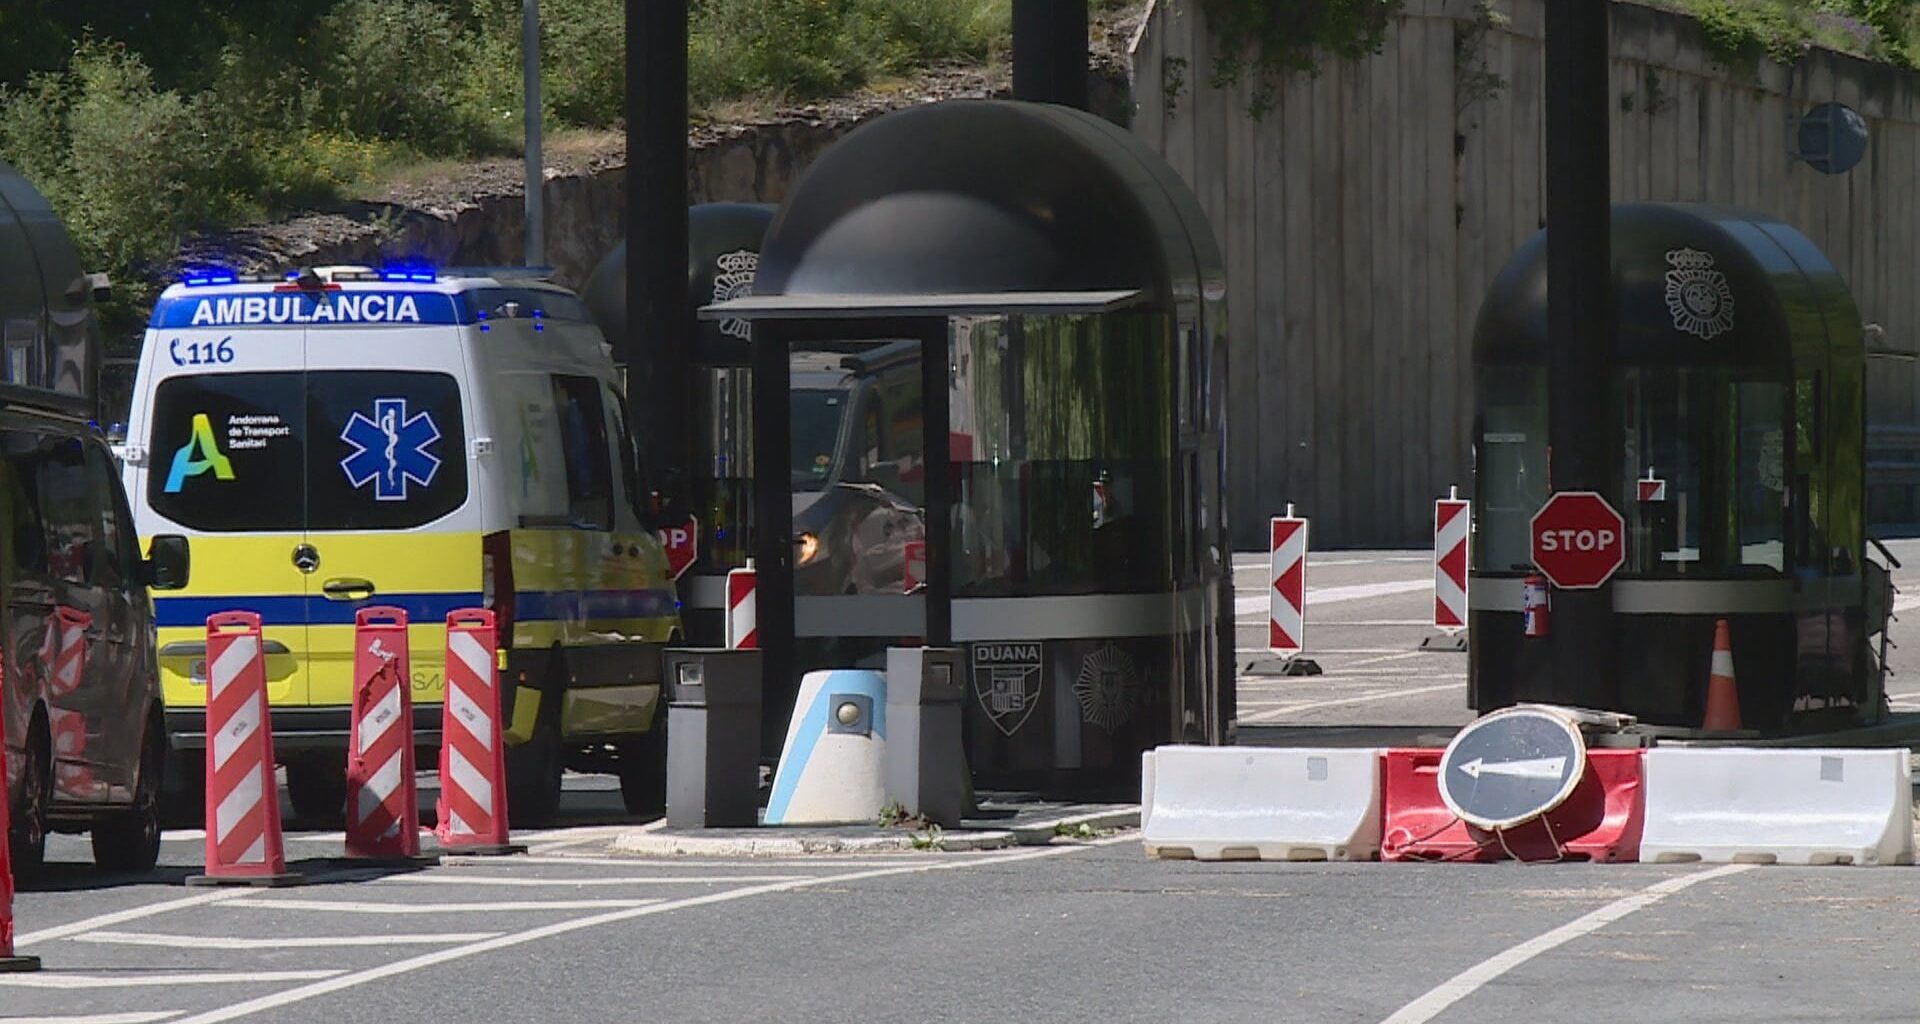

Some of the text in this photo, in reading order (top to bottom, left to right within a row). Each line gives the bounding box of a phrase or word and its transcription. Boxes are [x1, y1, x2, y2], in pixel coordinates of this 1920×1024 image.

[191, 295, 420, 325] AMBULANCIA
[187, 335, 234, 364] 116
[228, 415, 280, 425] Andorrana
[228, 426, 290, 437] de Transport
[229, 438, 267, 449] Sanitari
[1541, 529, 1615, 551] STOP
[977, 646, 1039, 661] DUANA
